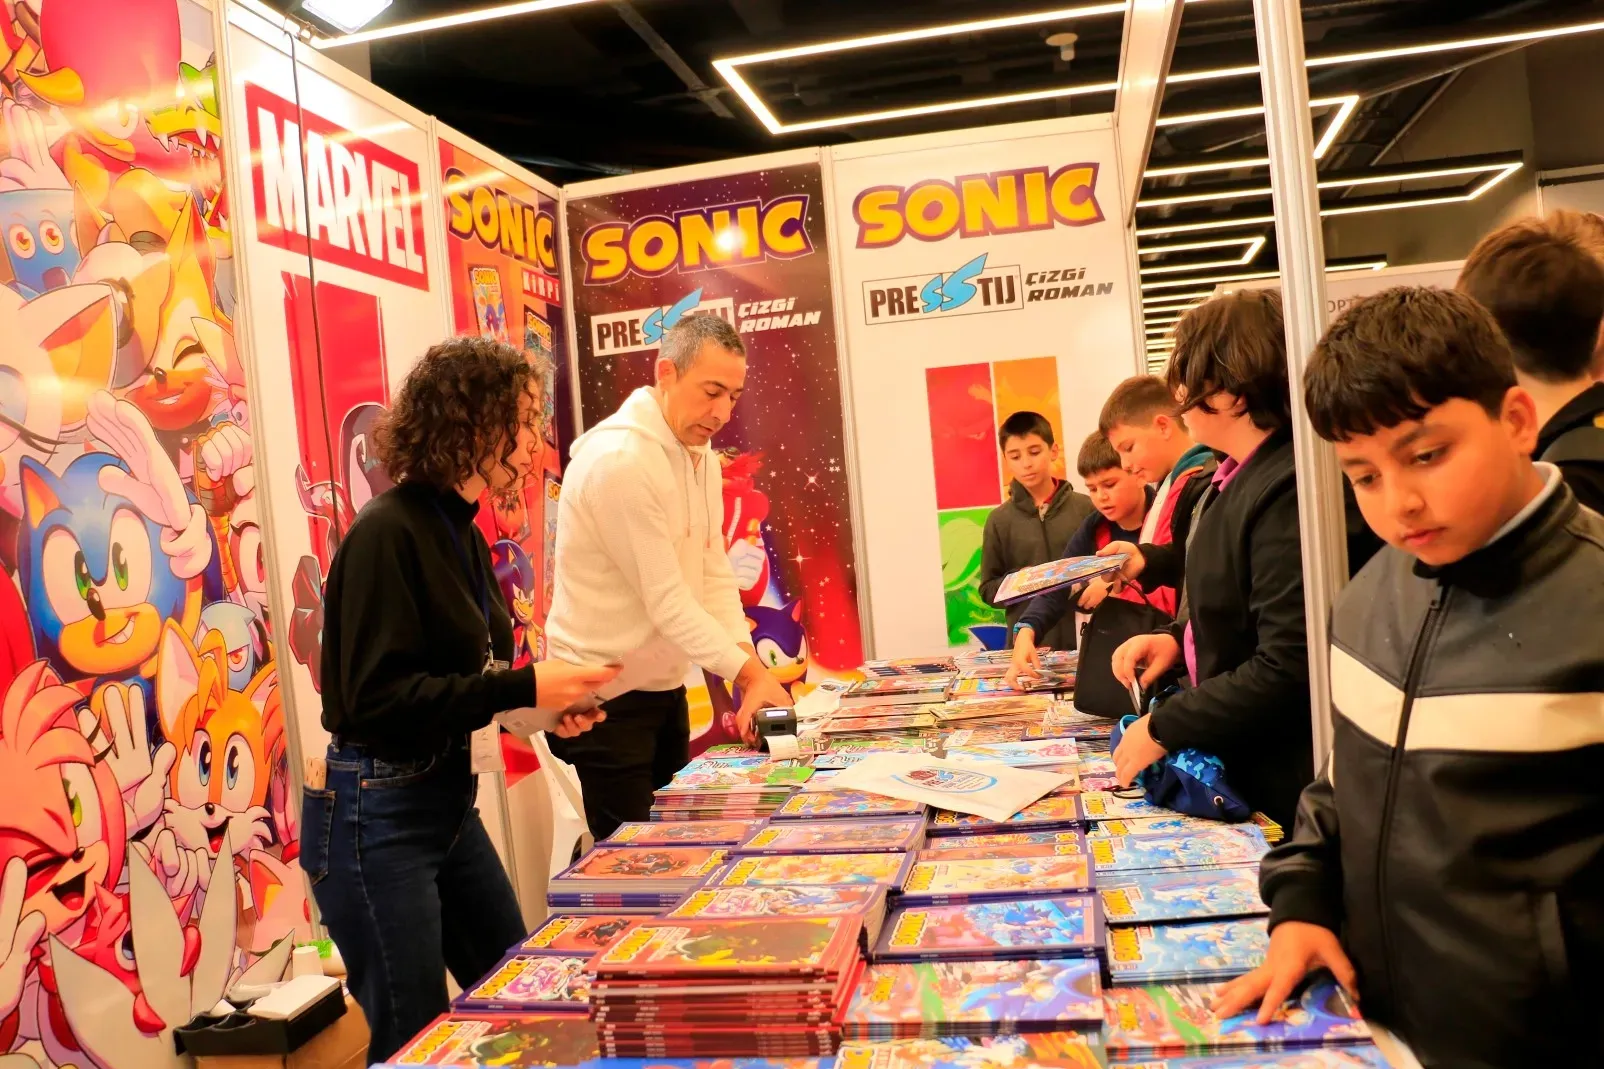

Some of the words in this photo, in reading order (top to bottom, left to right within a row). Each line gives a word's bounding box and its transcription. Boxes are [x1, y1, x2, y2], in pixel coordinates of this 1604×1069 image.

[257, 106, 423, 273] MARVEL
[446, 169, 557, 272] SONIC
[855, 165, 1102, 246] SONIC
[584, 198, 811, 283] SONIC
[739, 311, 821, 334] ROMAN
[1027, 282, 1113, 303] ROMAN
